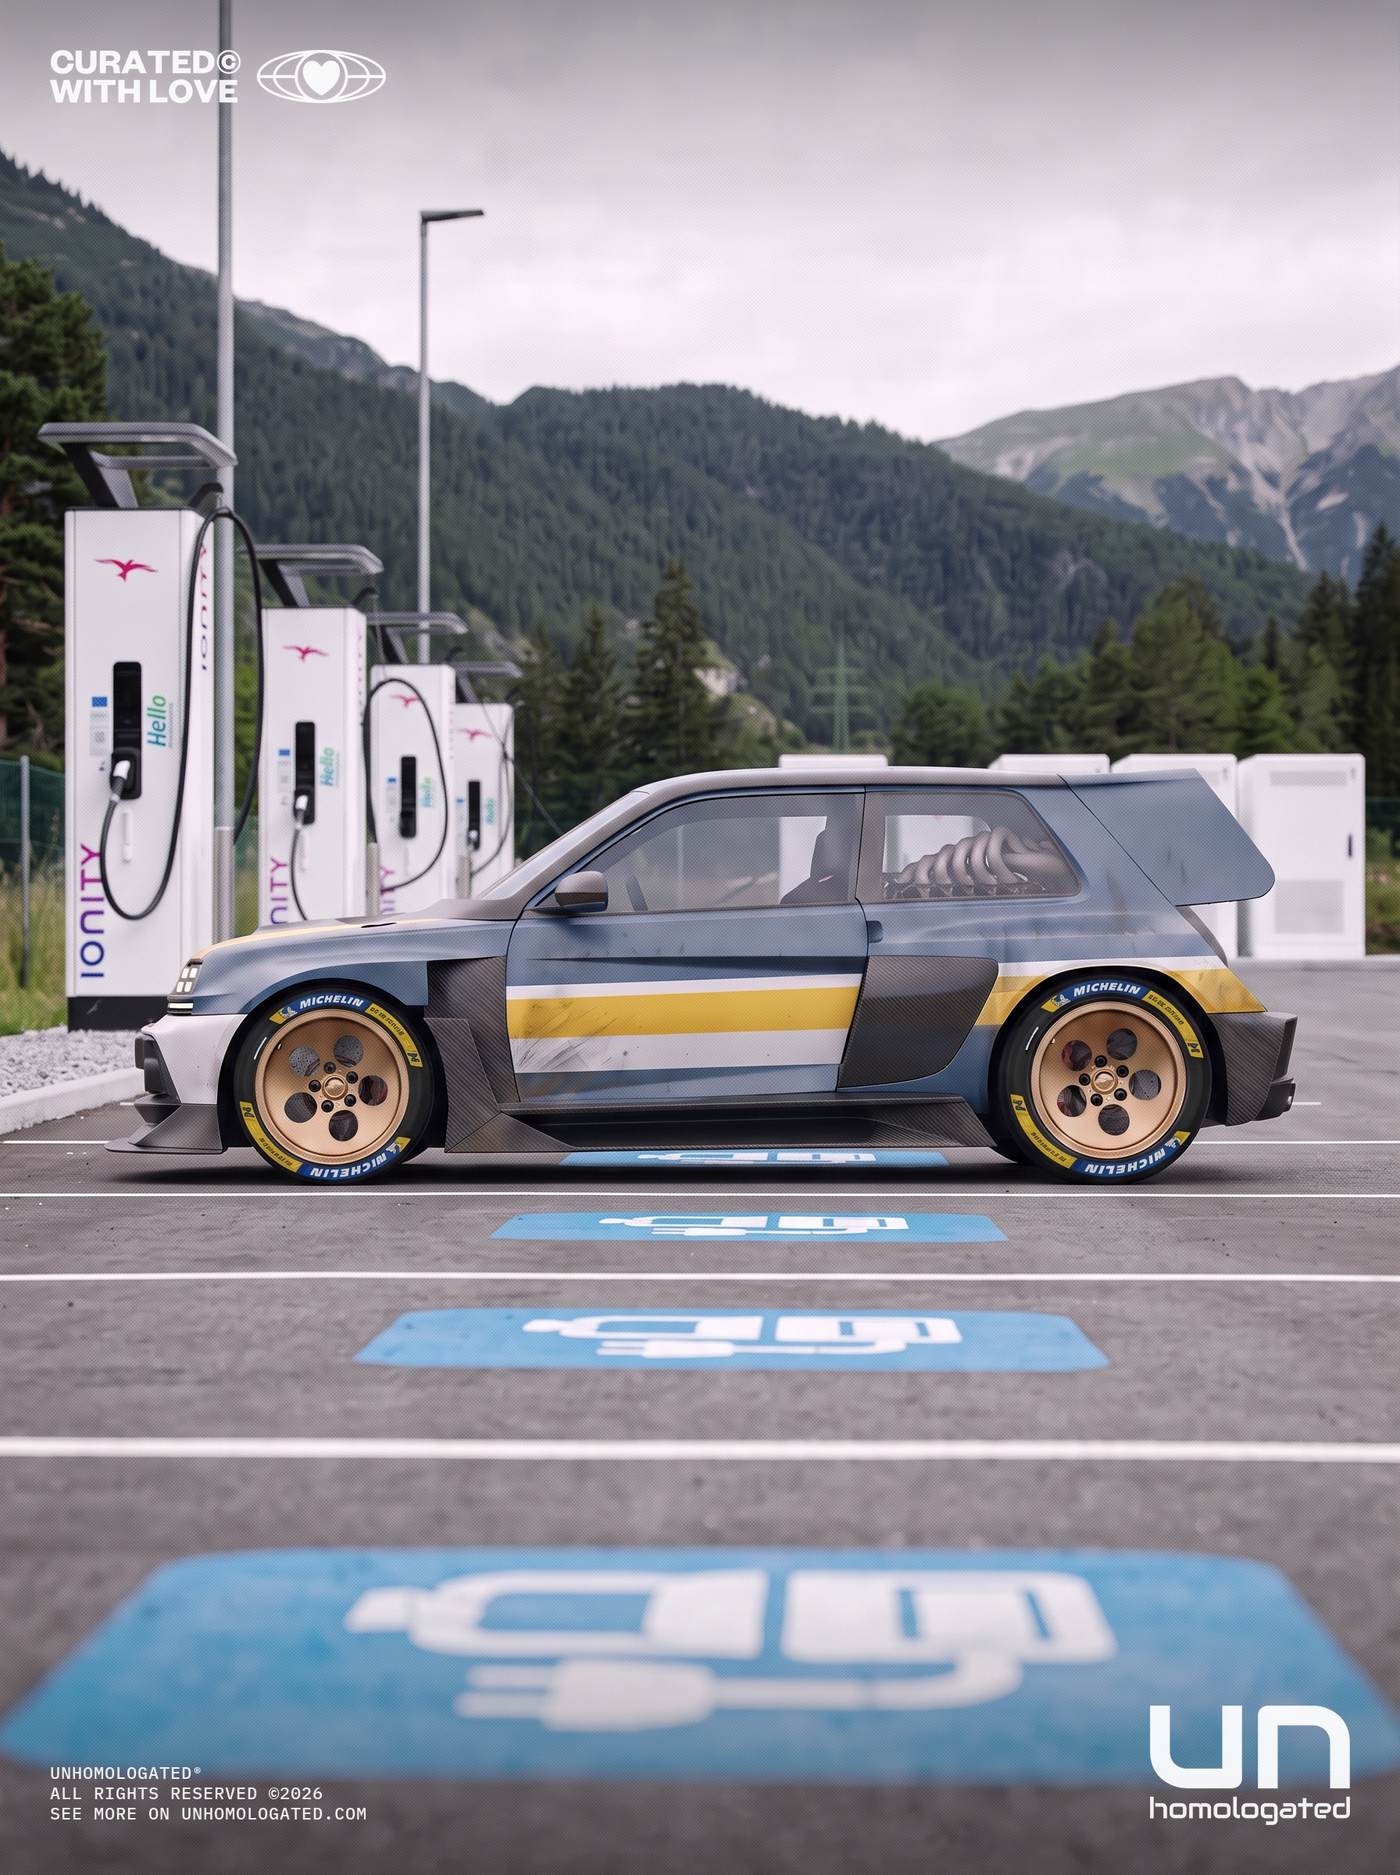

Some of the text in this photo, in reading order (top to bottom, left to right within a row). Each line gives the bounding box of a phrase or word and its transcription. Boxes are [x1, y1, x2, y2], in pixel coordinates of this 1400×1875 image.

[147, 695, 166, 747] Hello
[271, 857, 288, 924] NITY
[80, 843, 105, 977] IONITY
[299, 994, 364, 1010] MICHELIN
[1073, 982, 1141, 997] MICHELIN
[310, 1152, 388, 1178] MICHELIN
[1084, 1147, 1166, 1175] MICHELIN
